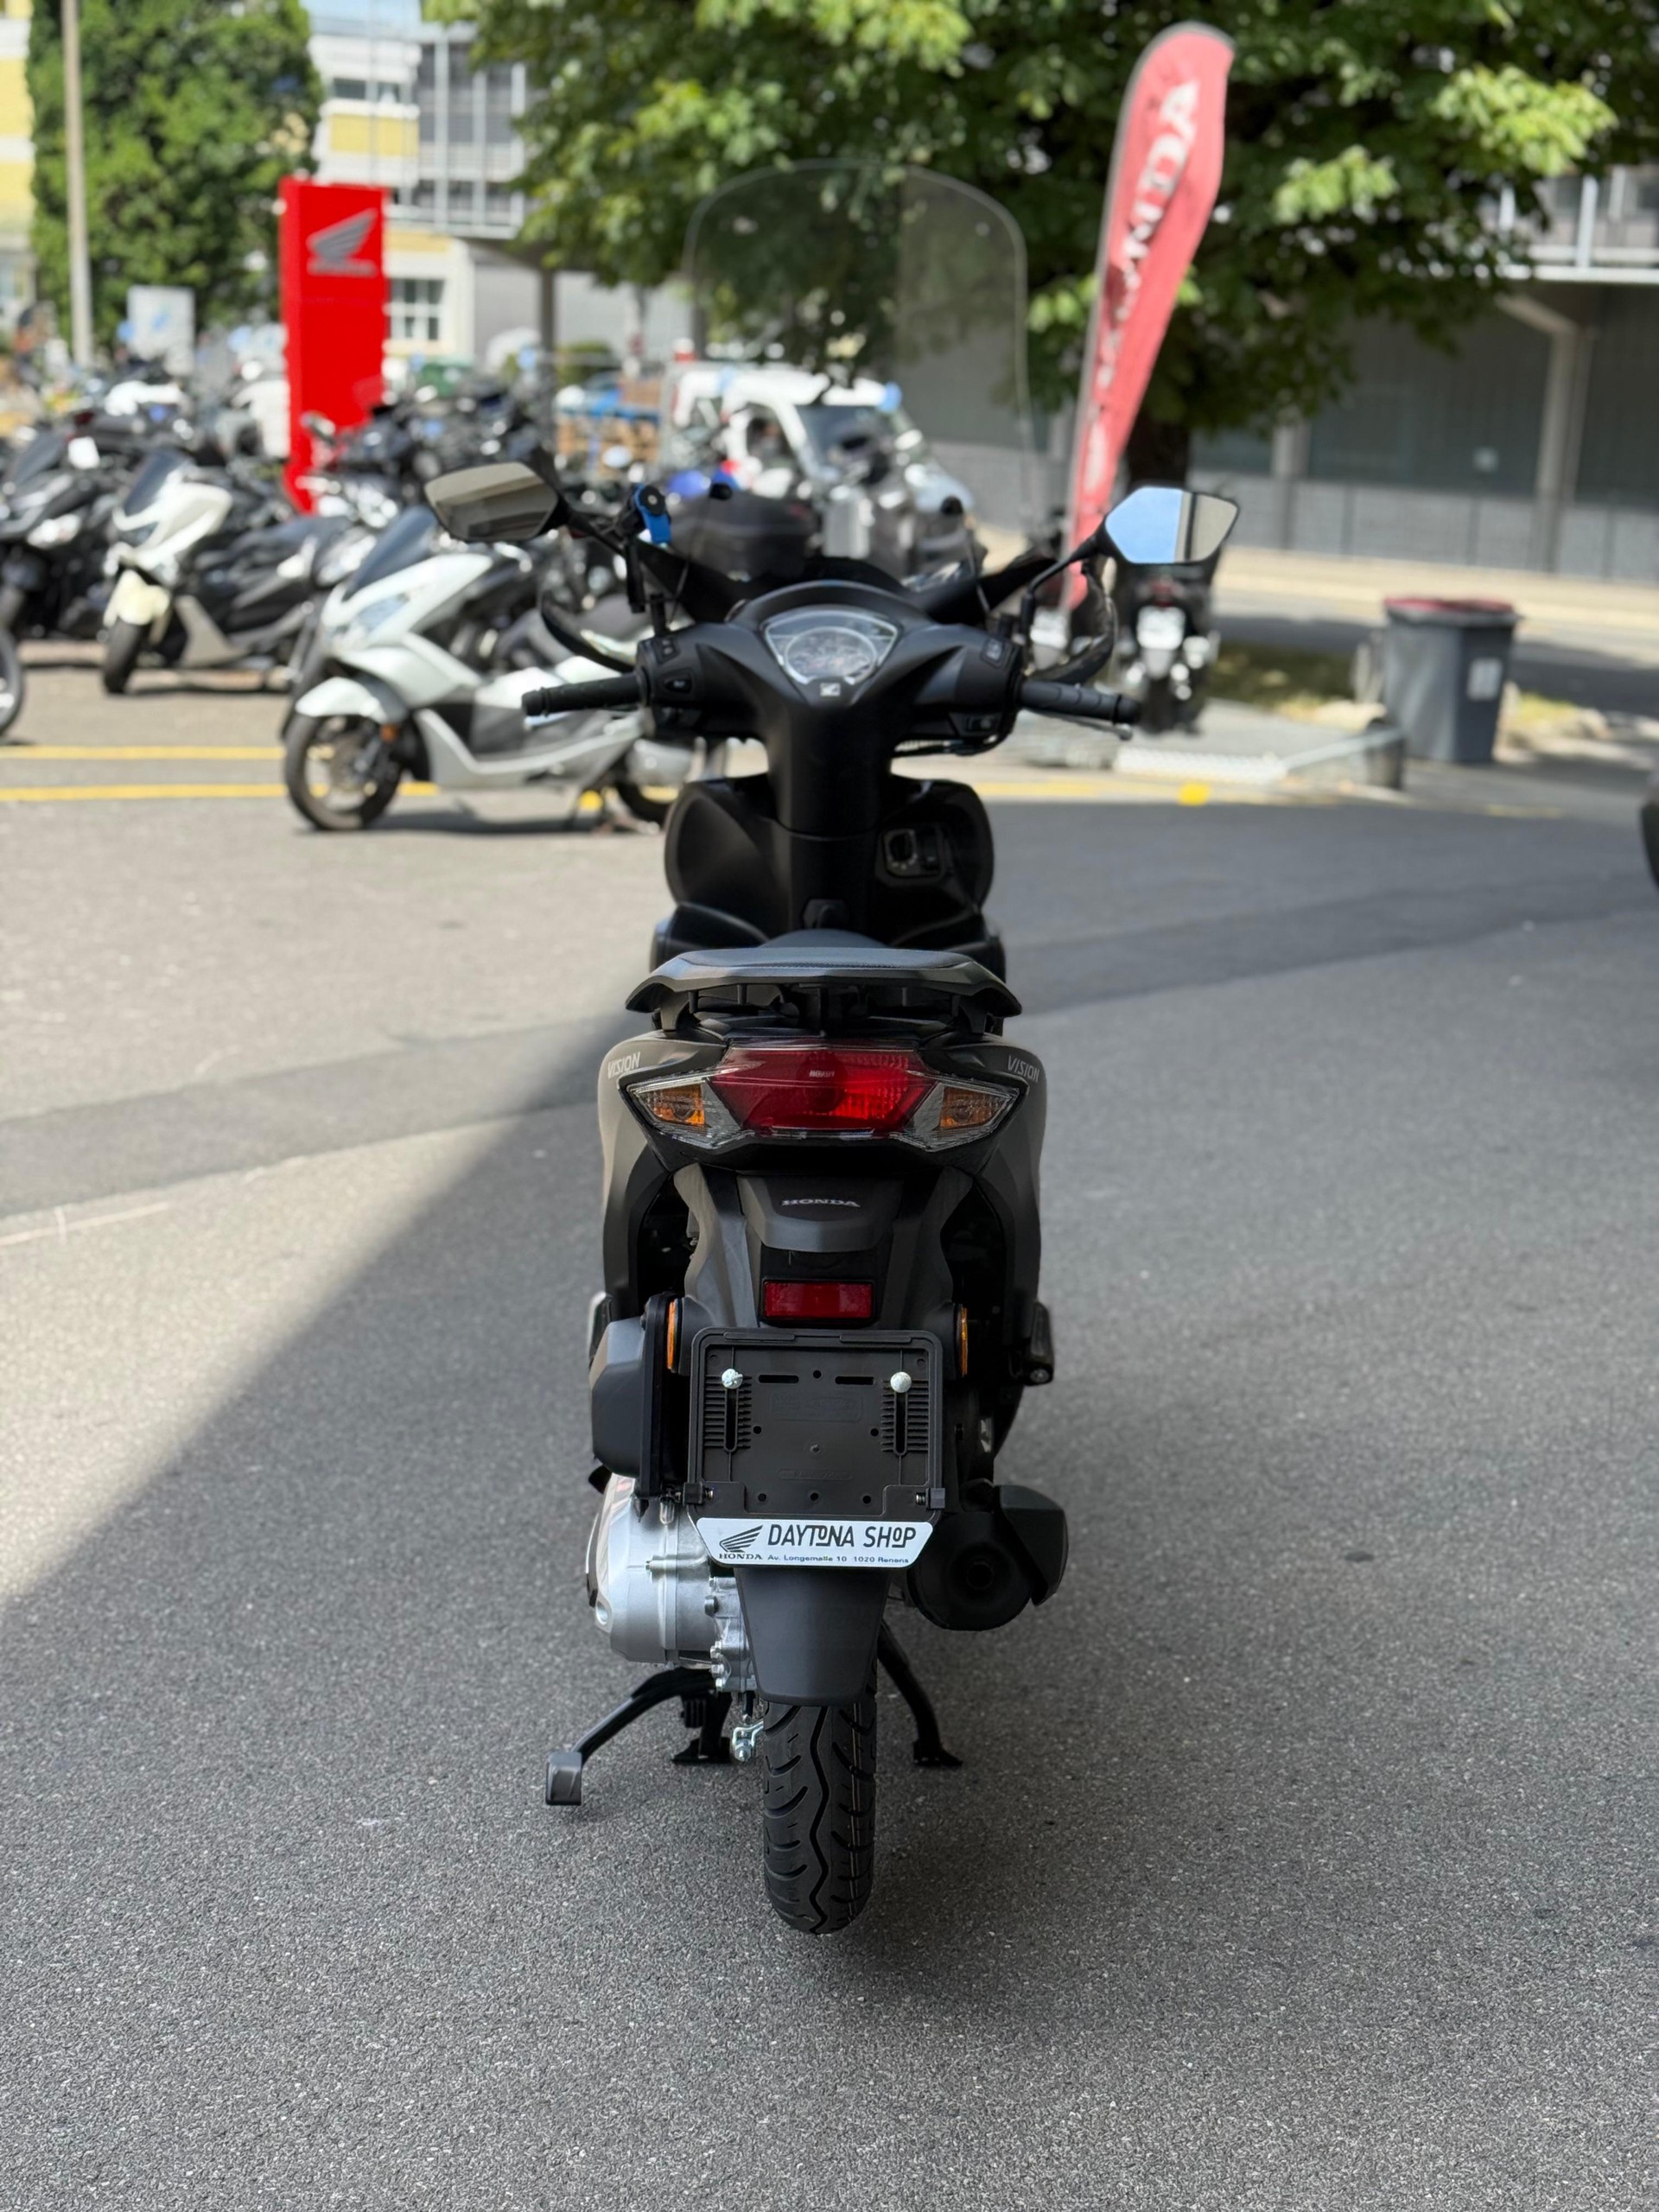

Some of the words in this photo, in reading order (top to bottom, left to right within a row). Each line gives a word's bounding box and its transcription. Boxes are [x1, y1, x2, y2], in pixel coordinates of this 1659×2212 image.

[607, 1051, 641, 1079] VISION
[1007, 1054, 1040, 1084] VISION
[781, 1198, 861, 1208] HONDA
[767, 1523, 855, 1548] DAYTONA
[863, 1526, 917, 1548] SHOP
